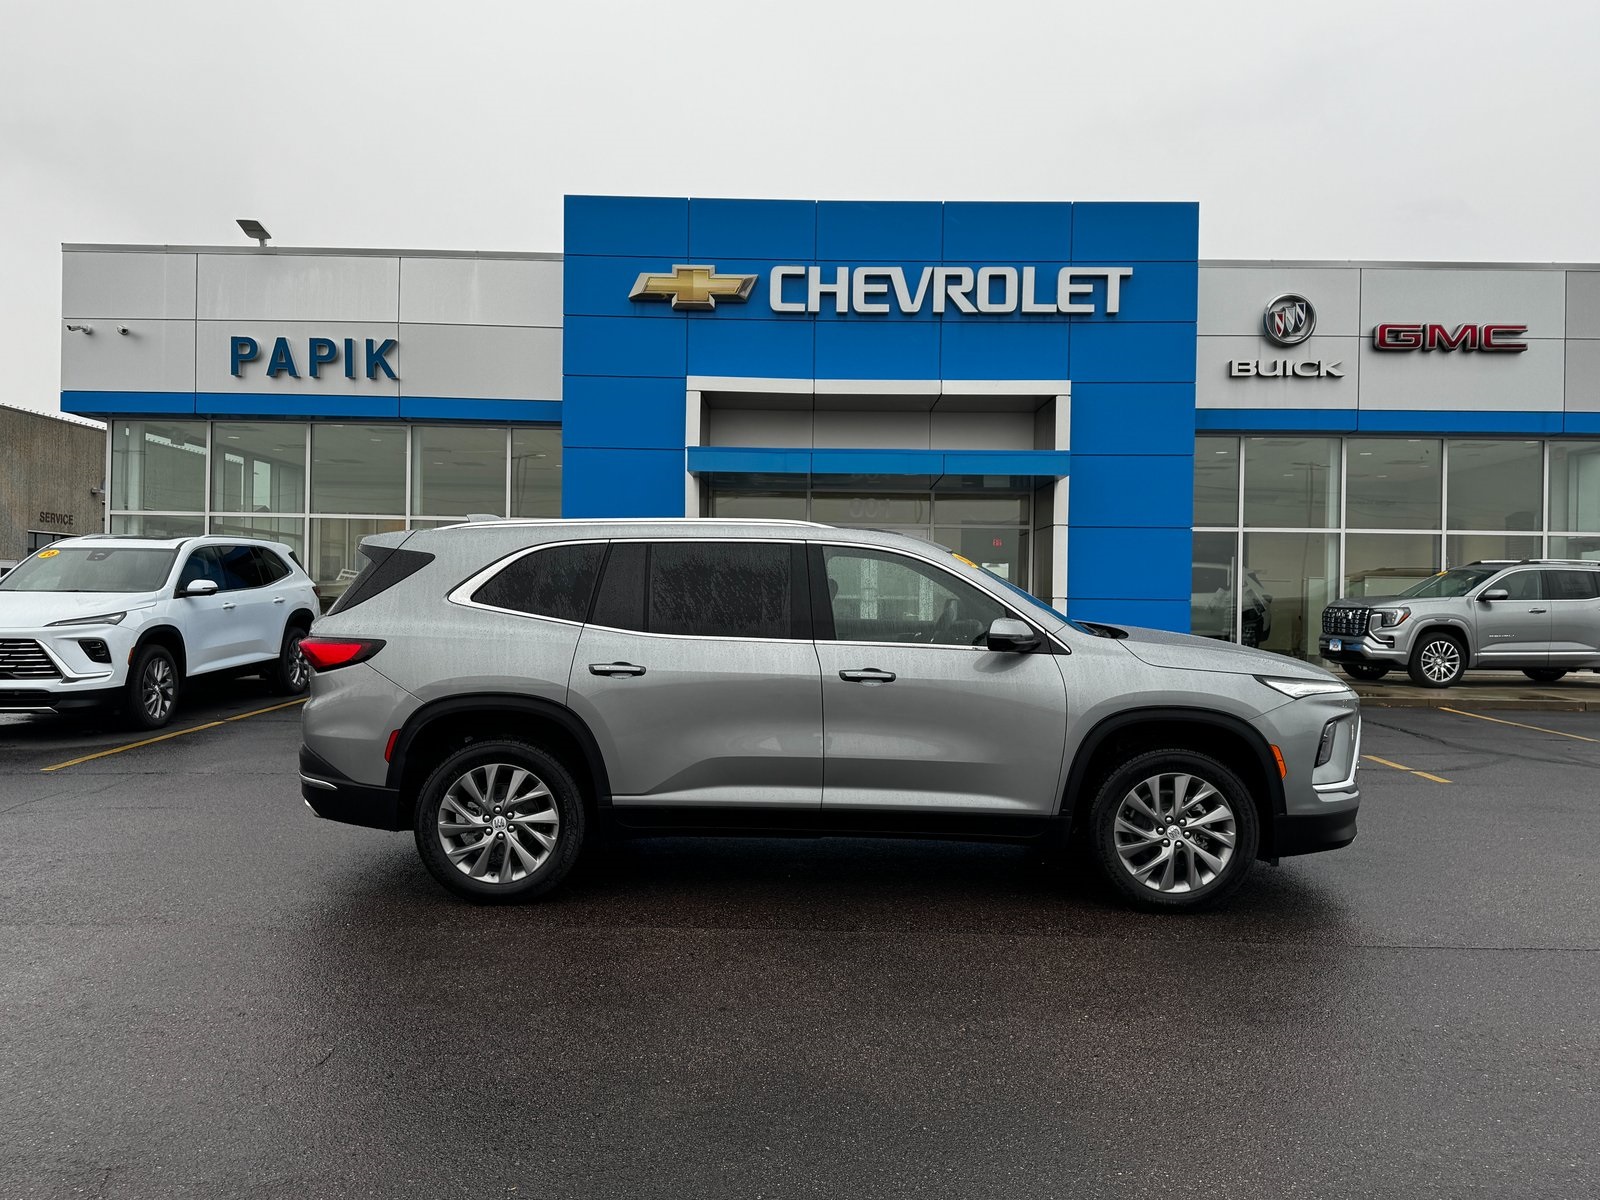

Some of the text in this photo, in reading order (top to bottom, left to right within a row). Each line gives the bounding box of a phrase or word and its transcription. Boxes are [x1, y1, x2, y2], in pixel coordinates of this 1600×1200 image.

[769, 265, 1134, 314] CHEVROLET
[1373, 322, 1529, 352] GMC
[230, 336, 399, 381] PAPIK
[1228, 359, 1346, 378] BUICK
[39, 511, 74, 526] SERVICE
